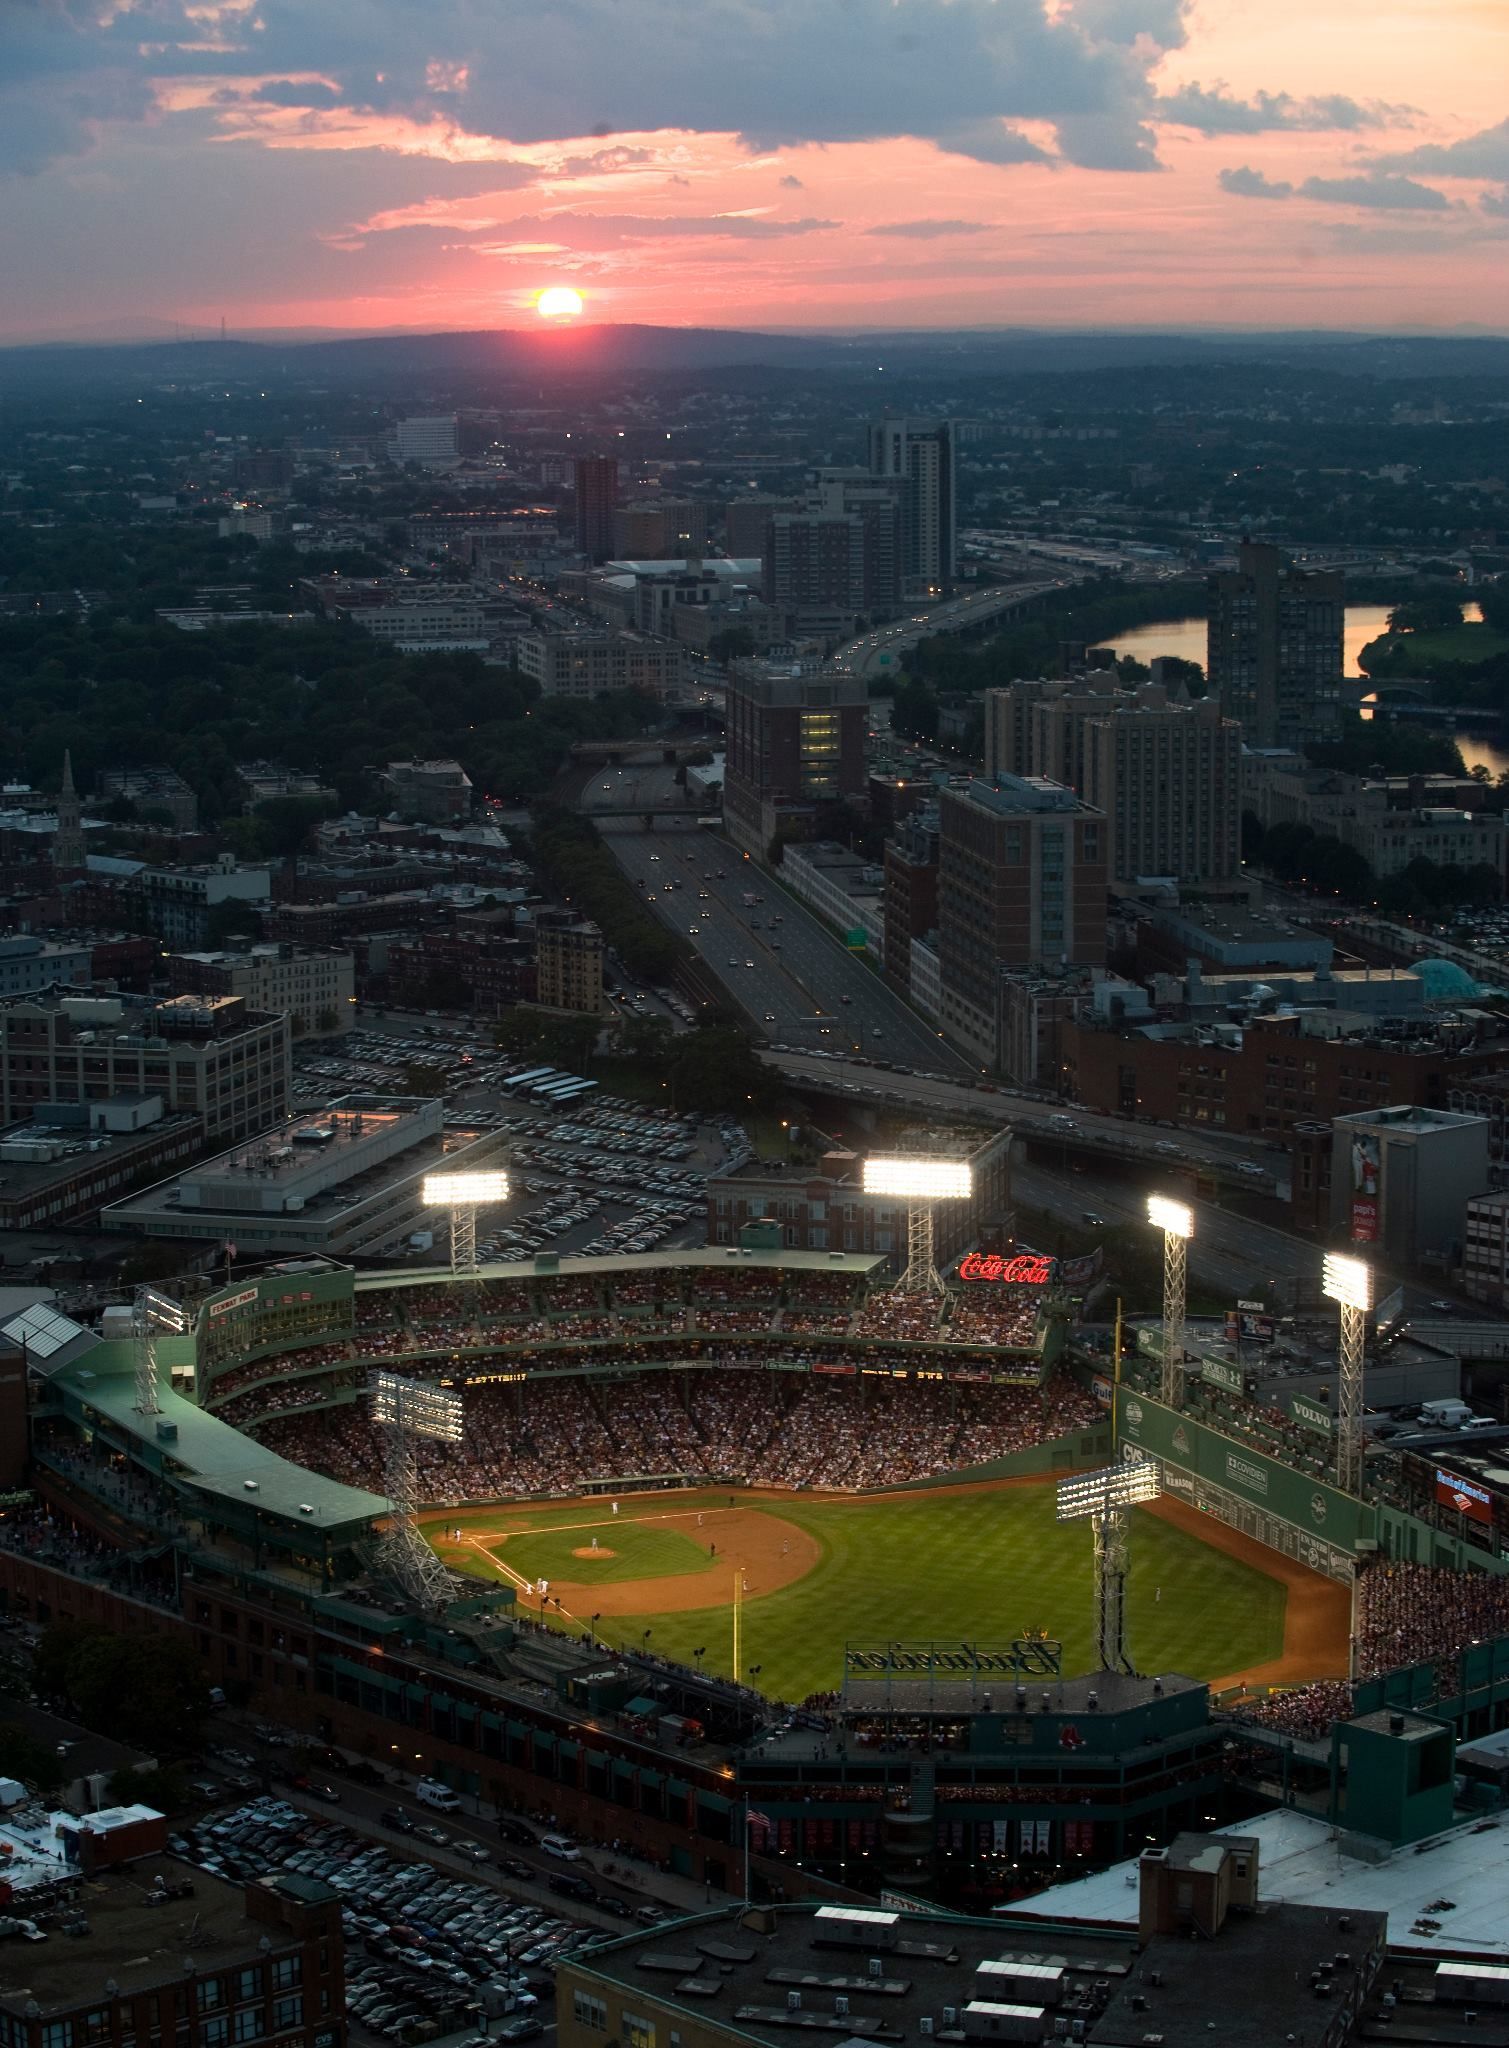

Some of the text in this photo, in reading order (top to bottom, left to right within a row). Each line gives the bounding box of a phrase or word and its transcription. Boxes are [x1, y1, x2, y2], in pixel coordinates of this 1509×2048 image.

[960, 1253, 1053, 1283] Coca-Cola
[212, 1290, 256, 1314] FENWAY PARK
[1093, 1382, 1112, 1401] Gulf
[1292, 1401, 1330, 1428] VOLVO
[1123, 1443, 1143, 1462] CVS
[315, 2033, 333, 2044] CVS
